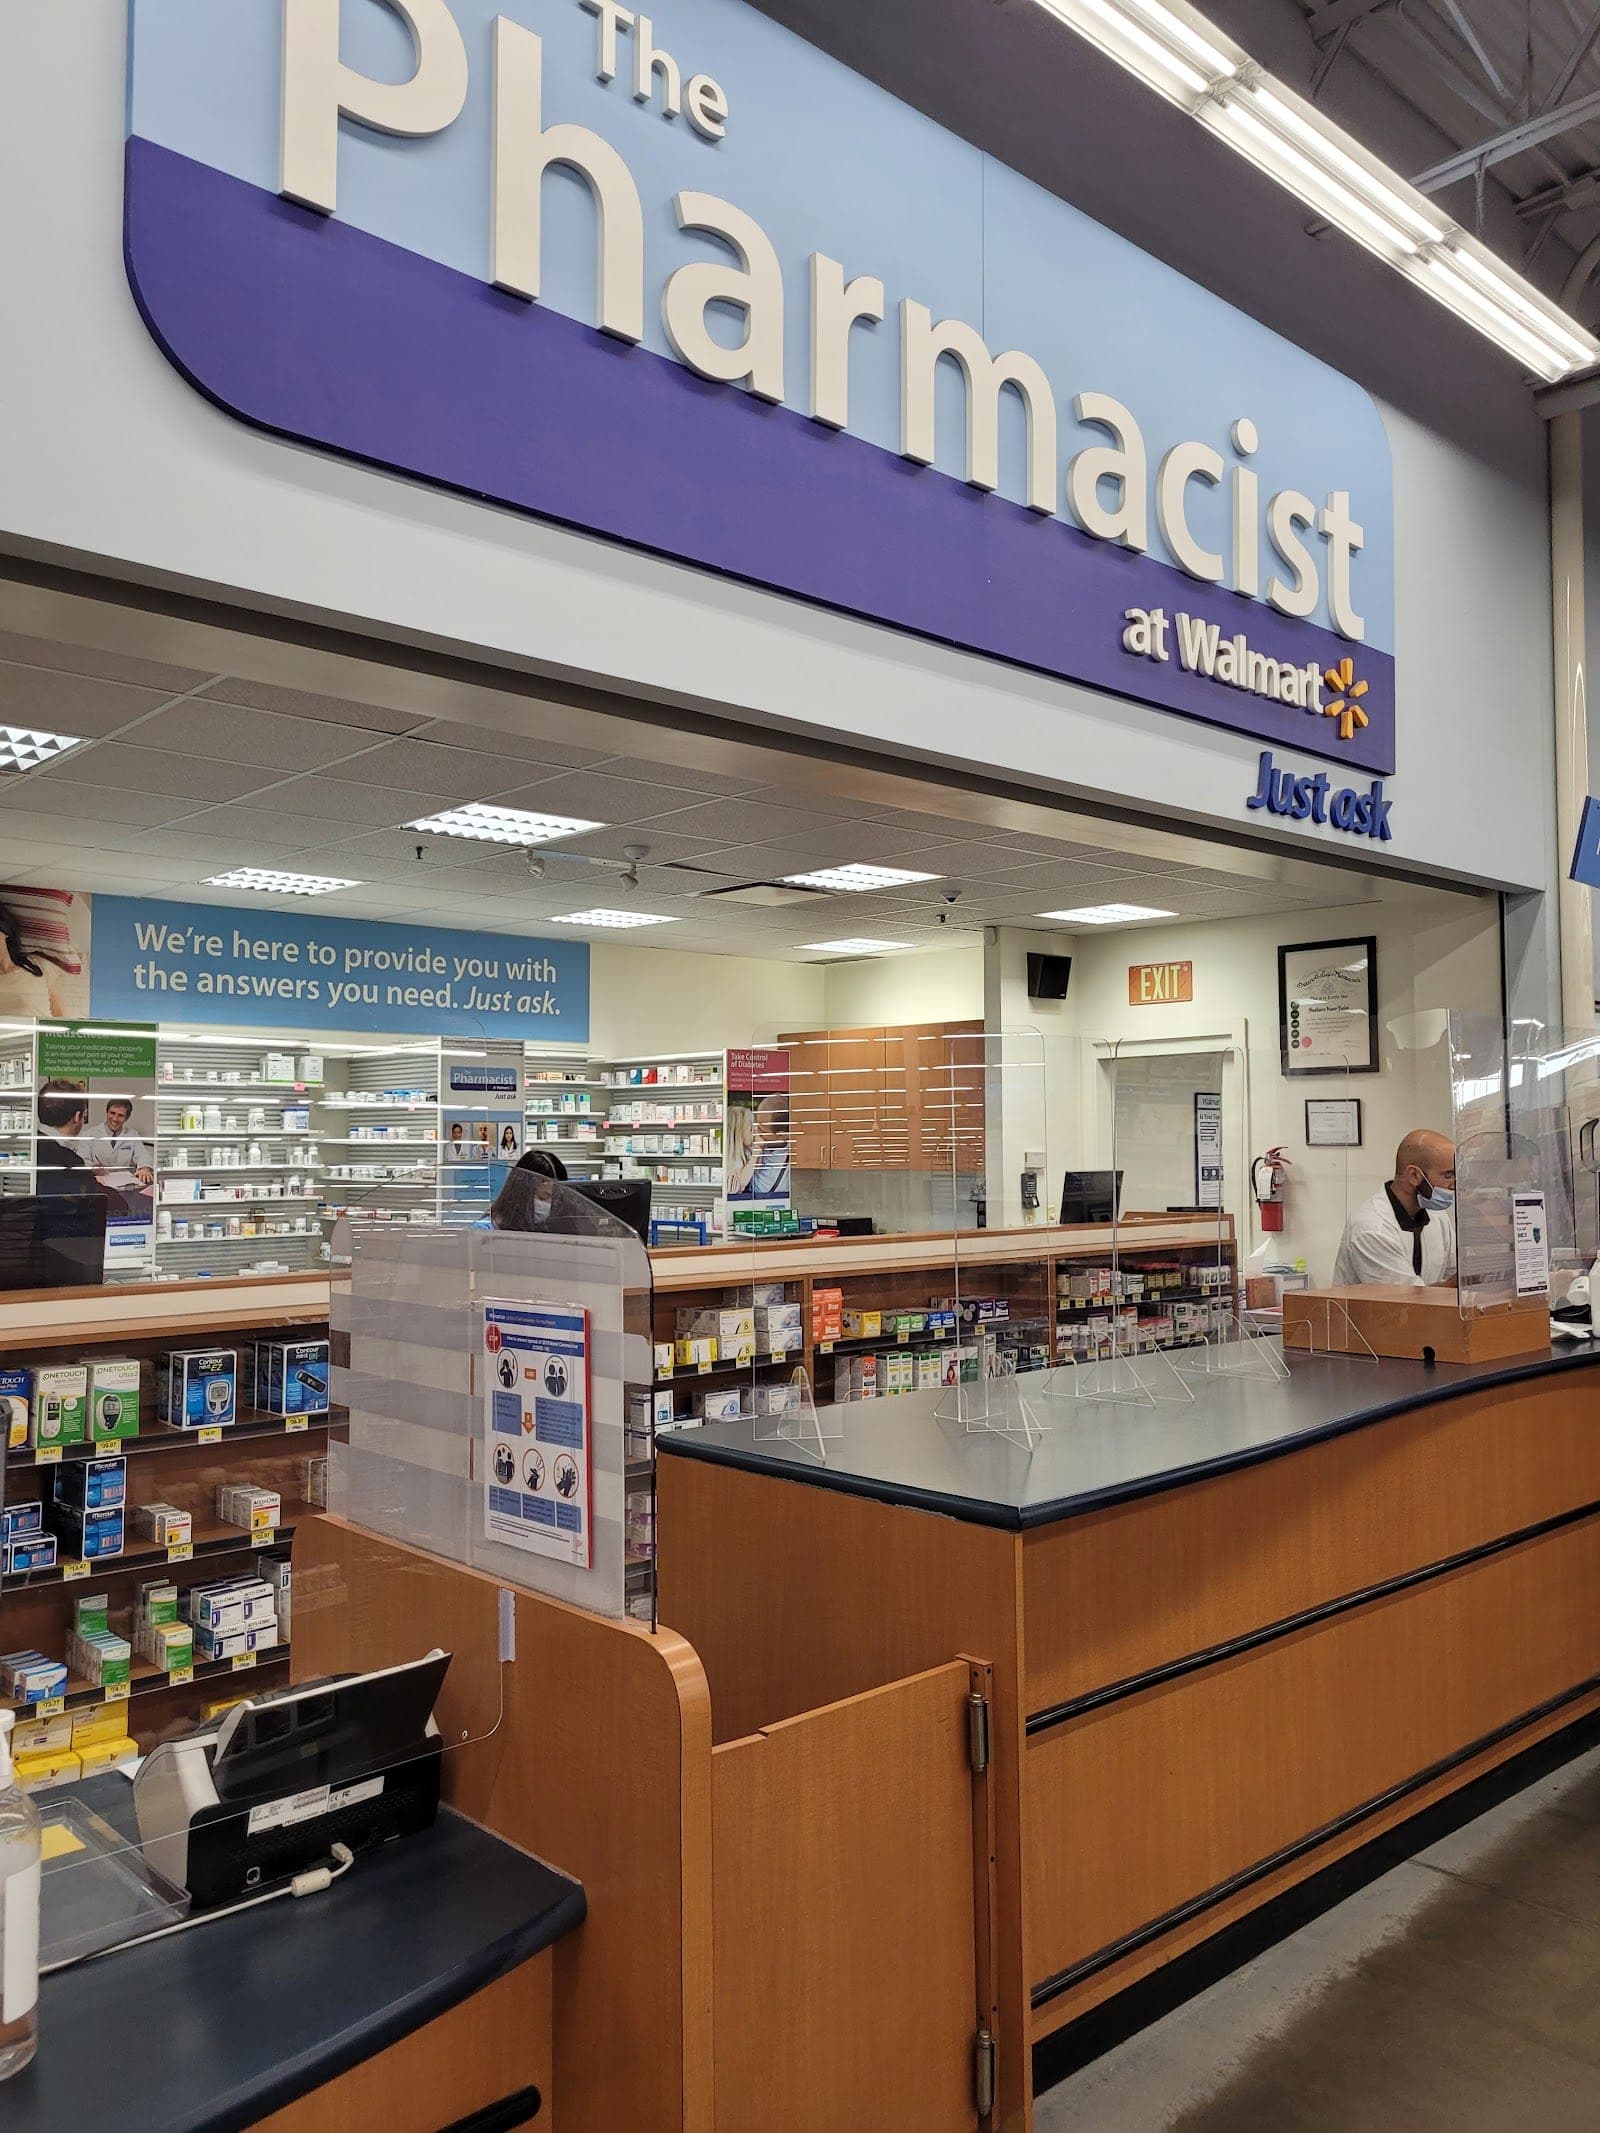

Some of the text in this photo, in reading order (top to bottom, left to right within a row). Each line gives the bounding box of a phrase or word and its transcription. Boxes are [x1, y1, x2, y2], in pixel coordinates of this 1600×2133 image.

[577, 0, 730, 142] The
[279, 0, 1366, 642] Pharmacist
[1122, 607, 1325, 714] at Walmart
[1247, 751, 1392, 841] Just ask
[233, 930, 299, 963] here
[307, 941, 337, 966] to
[344, 946, 447, 975] provide
[453, 957, 498, 982] you
[505, 958, 557, 983] with
[1140, 964, 1181, 1000] EXIT
[133, 961, 561, 1016] the answers you need. Just ask.
[454, 1070, 514, 1085] Pharmacist
[731, 1052, 768, 1062] Take Control
